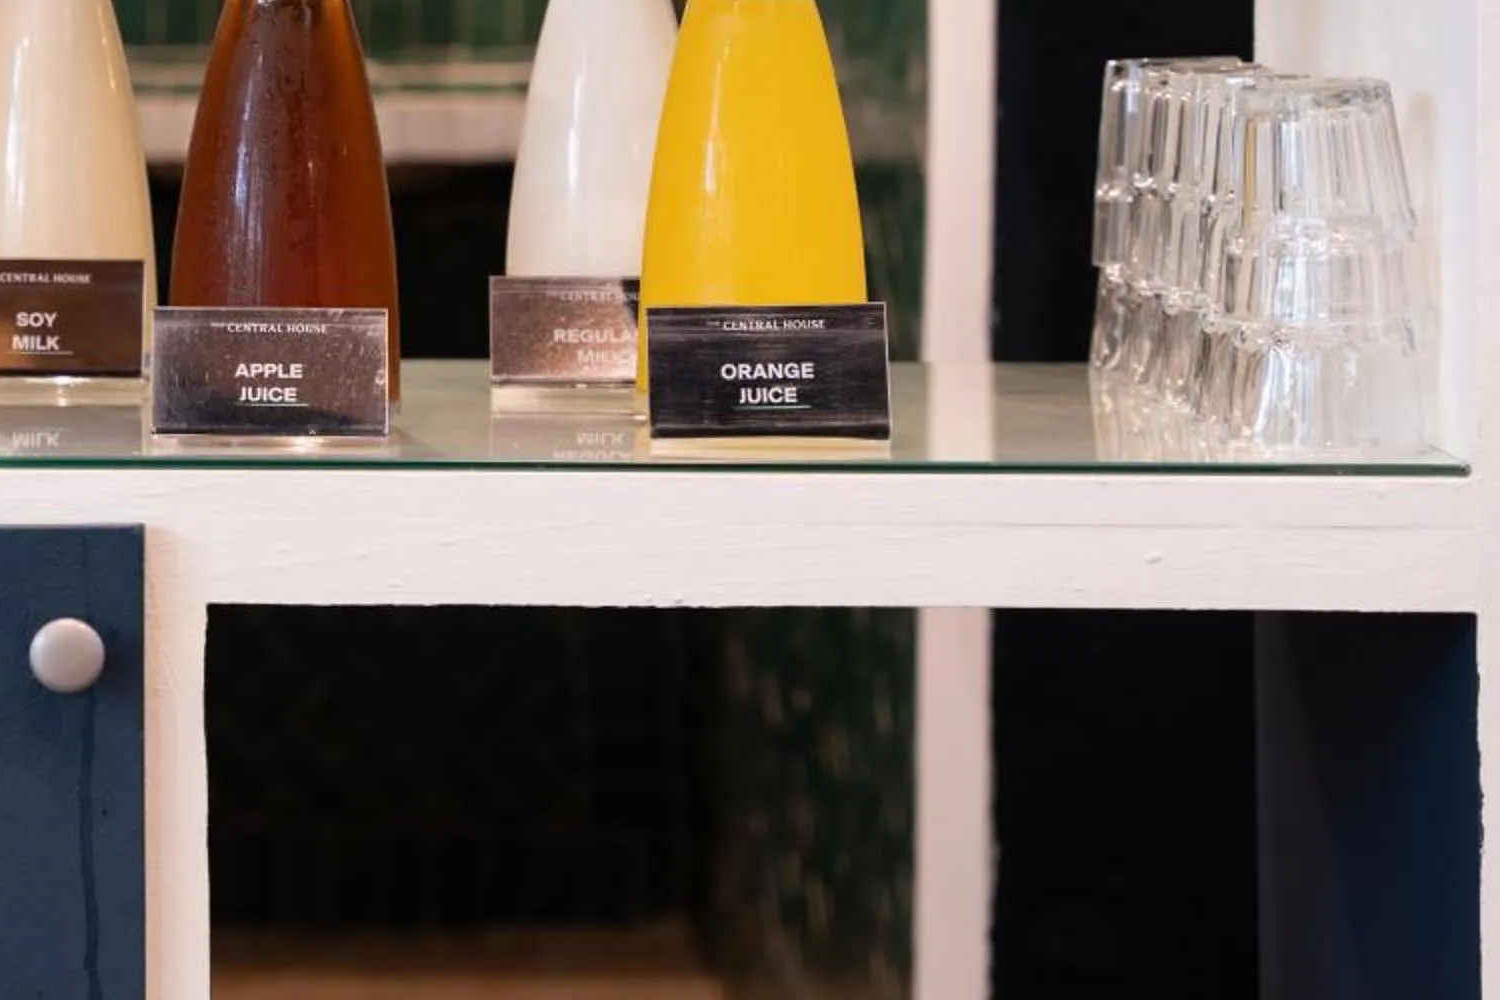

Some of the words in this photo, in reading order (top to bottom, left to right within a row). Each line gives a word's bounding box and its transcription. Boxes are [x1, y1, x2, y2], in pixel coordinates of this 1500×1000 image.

[0, 273, 51, 284] CENTRAL
[53, 273, 91, 284] HOUSE
[15, 312, 57, 328] SOY
[227, 322, 283, 333] CENTRAL
[287, 322, 328, 333] HOUSE
[723, 320, 780, 331] CENTRAL
[783, 319, 826, 329] HOUSE
[12, 335, 60, 351] MILK
[235, 363, 303, 379] APPLE
[720, 362, 815, 380] ORANGE
[239, 387, 298, 402] JUICE
[739, 387, 798, 404] JUICE
